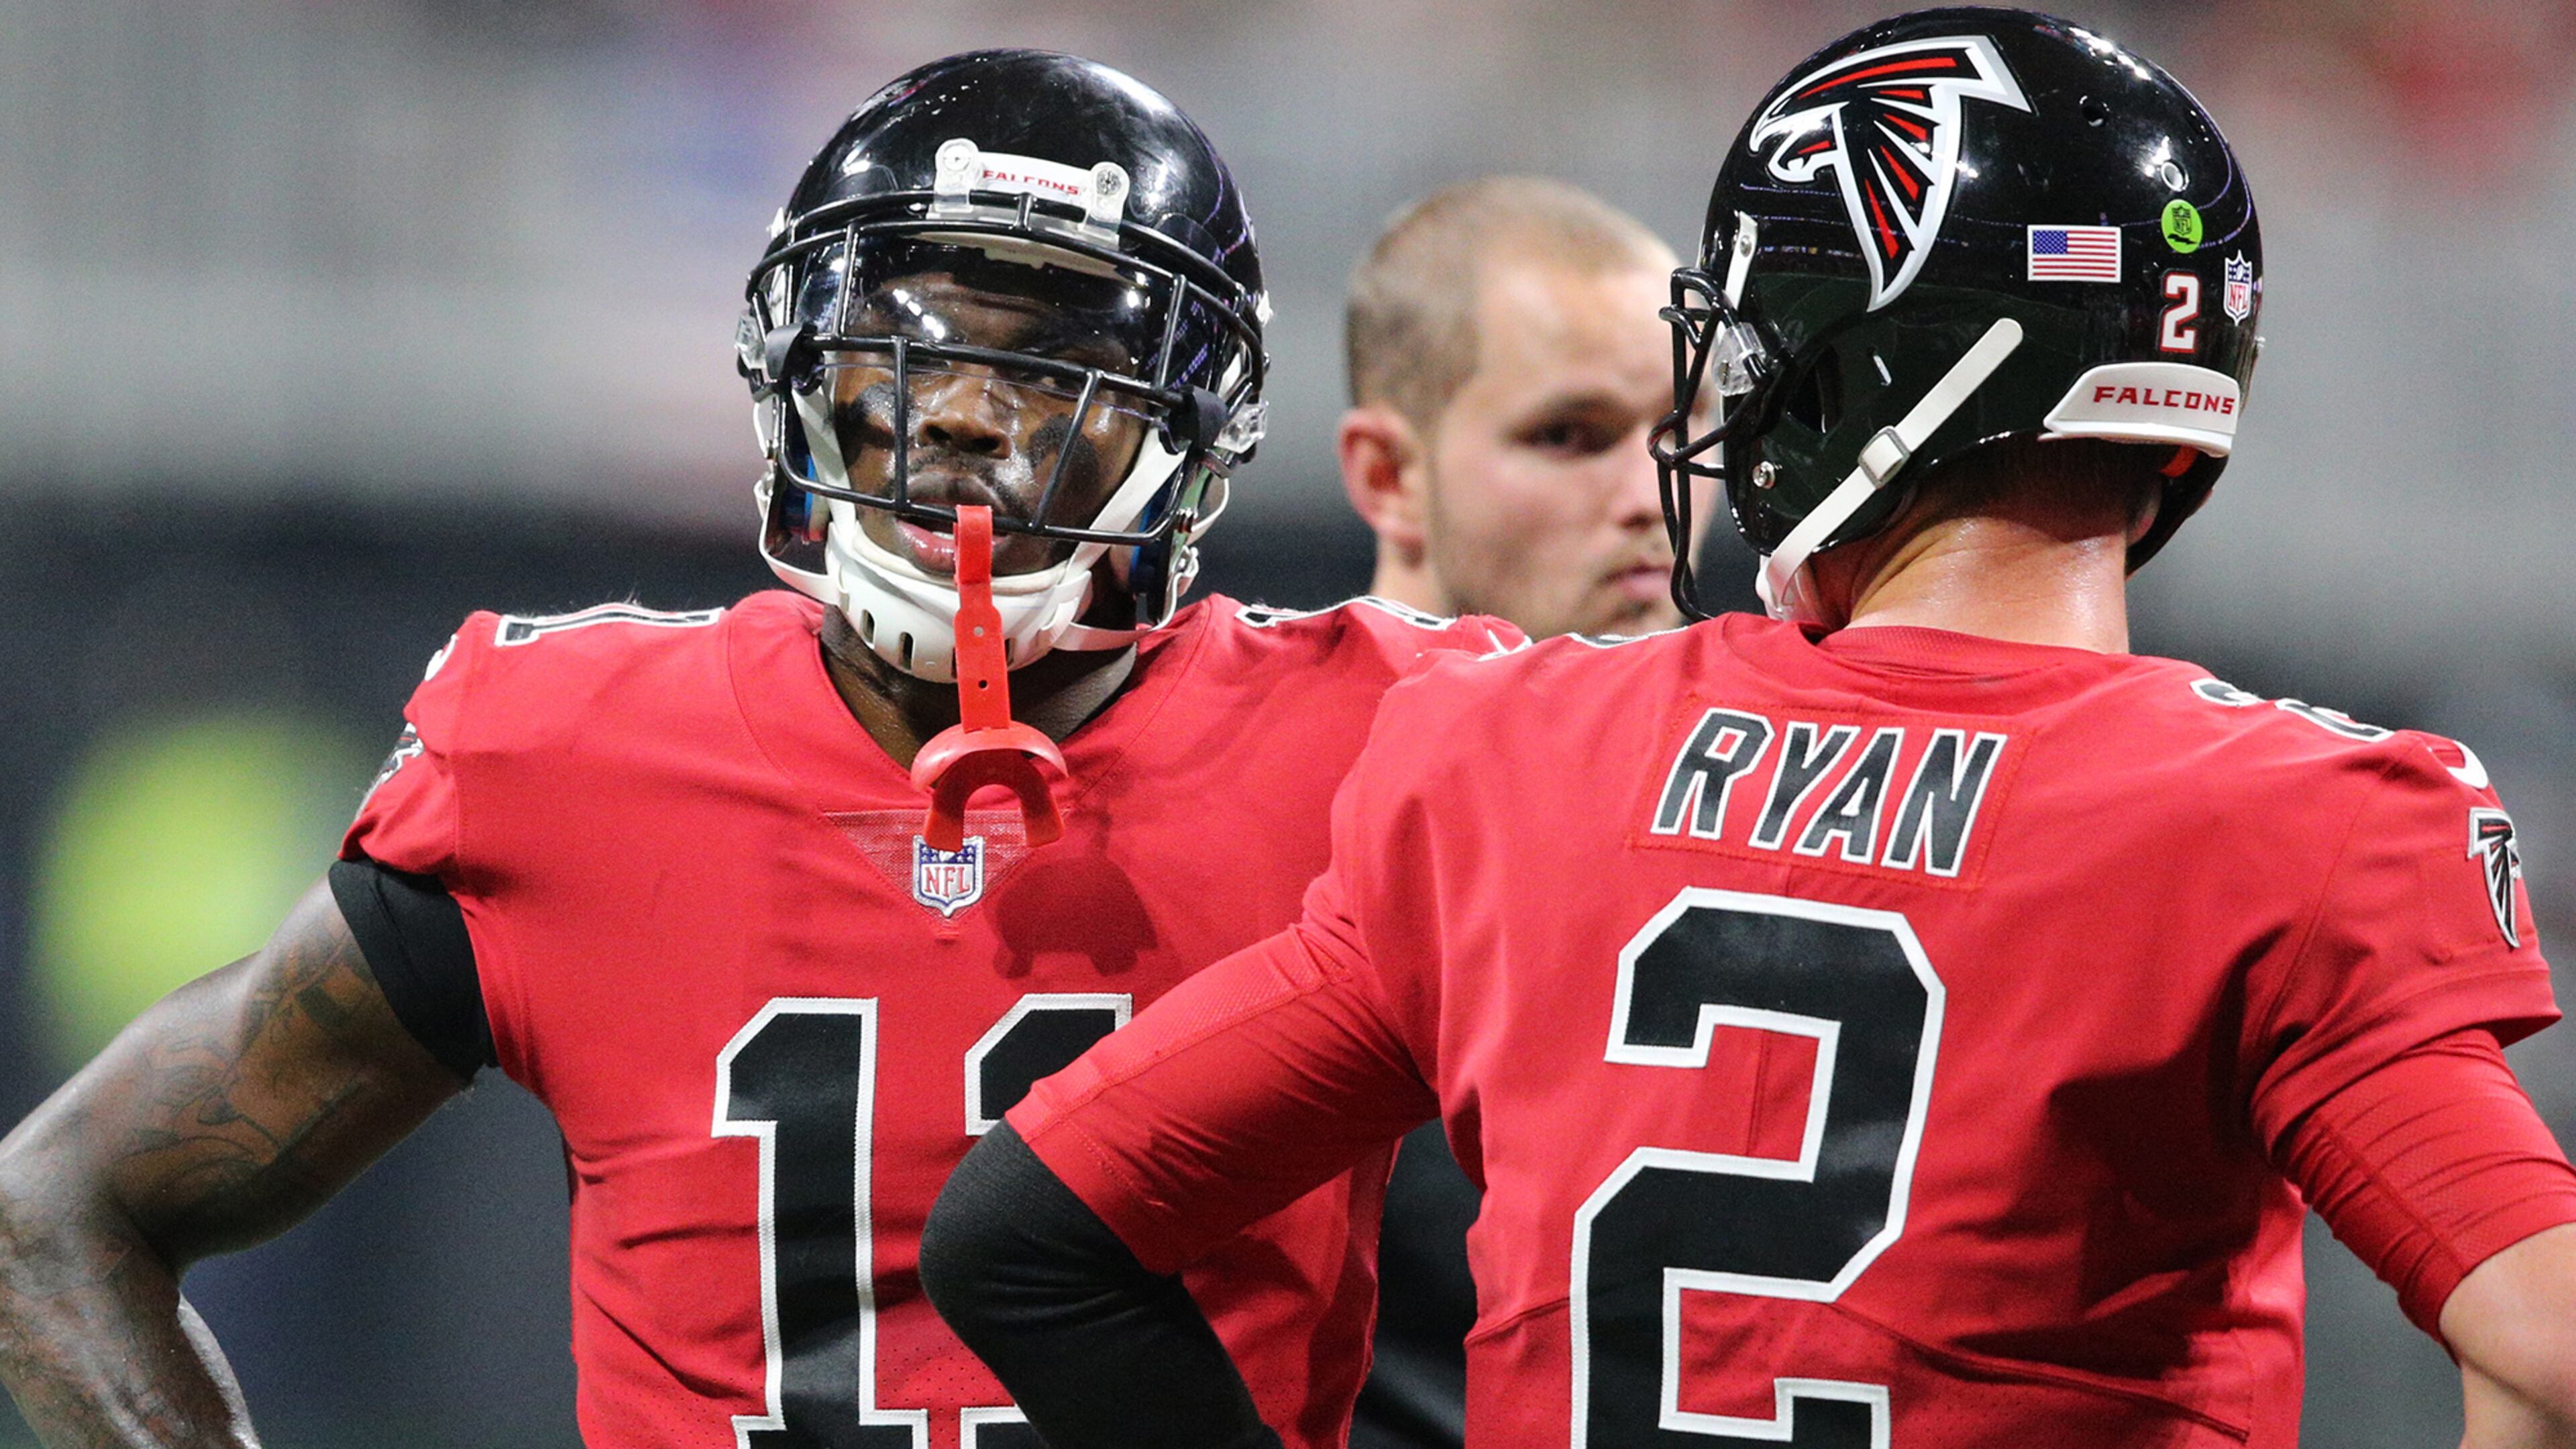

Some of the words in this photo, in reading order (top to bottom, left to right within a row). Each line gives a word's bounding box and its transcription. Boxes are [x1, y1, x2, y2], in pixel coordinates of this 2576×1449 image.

[2159, 271, 2201, 354] 2
[2229, 283, 2247, 312] NFL
[2093, 386, 2235, 415] FALCONS
[1650, 707, 2008, 878] RYAN
[924, 867, 971, 898] NFL
[1570, 886, 1947, 1449] 2
